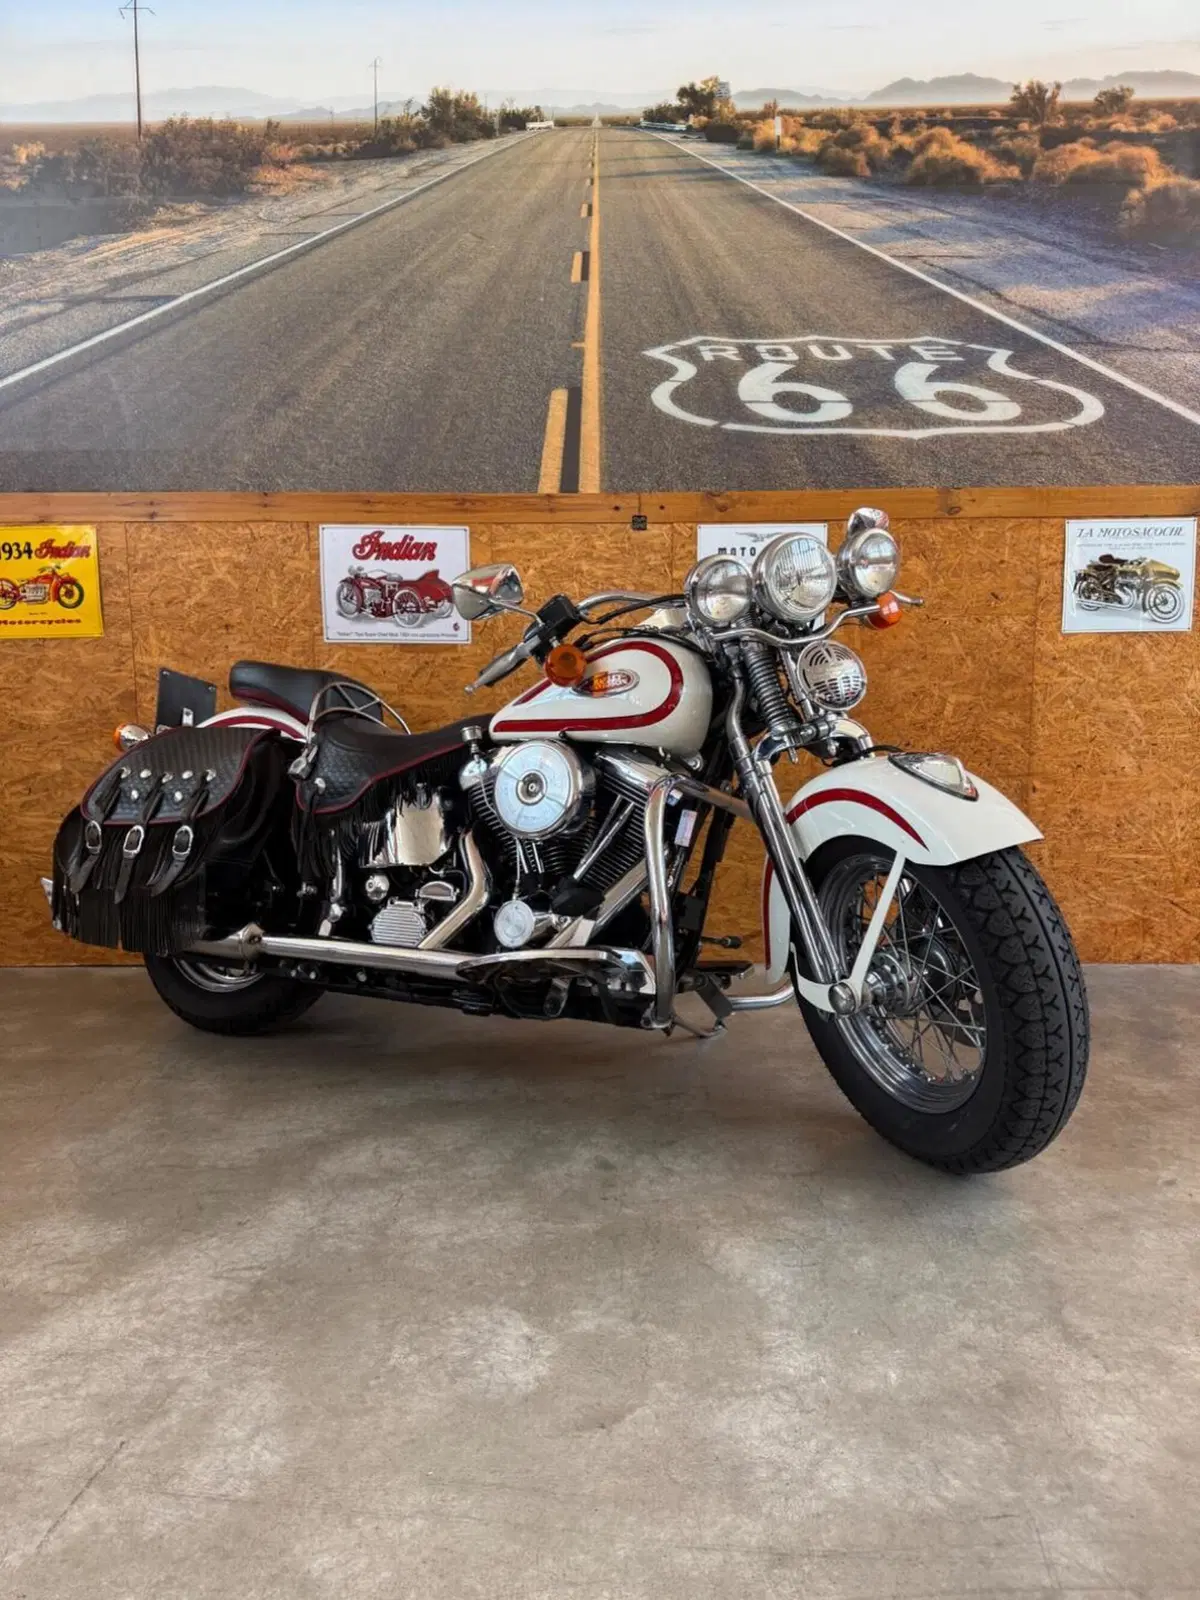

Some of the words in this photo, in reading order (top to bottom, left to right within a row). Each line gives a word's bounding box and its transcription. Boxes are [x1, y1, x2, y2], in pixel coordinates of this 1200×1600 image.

[699, 344, 965, 361] ROUTE
[738, 361, 1022, 422] 66
[1076, 527, 1093, 538] LA
[34, 537, 92, 559] Indian
[352, 530, 438, 561] Indian
